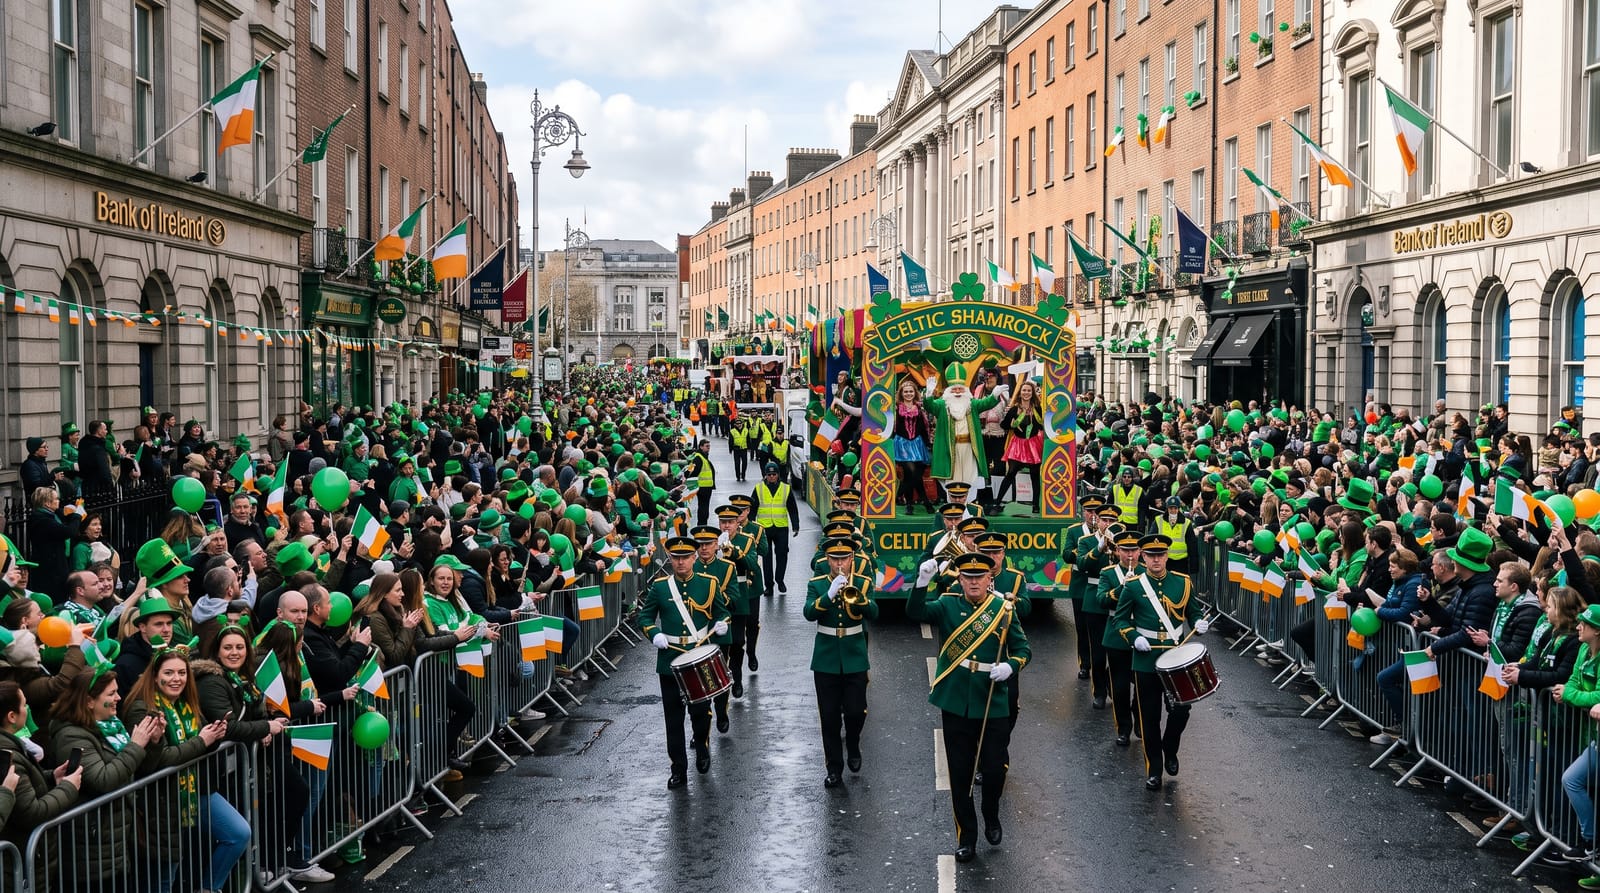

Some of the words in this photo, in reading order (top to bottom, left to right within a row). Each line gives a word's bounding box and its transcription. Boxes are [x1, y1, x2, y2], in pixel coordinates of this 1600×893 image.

[97, 191, 138, 228] Bank
[140, 203, 156, 231] of
[158, 206, 204, 241] Ireland
[1394, 227, 1425, 254] Bank
[1425, 224, 1438, 248] of
[1440, 214, 1485, 247] Ireland
[885, 311, 946, 343] CELTIC
[951, 309, 1053, 345] SHAMROCK
[879, 532, 927, 550] CELTI
